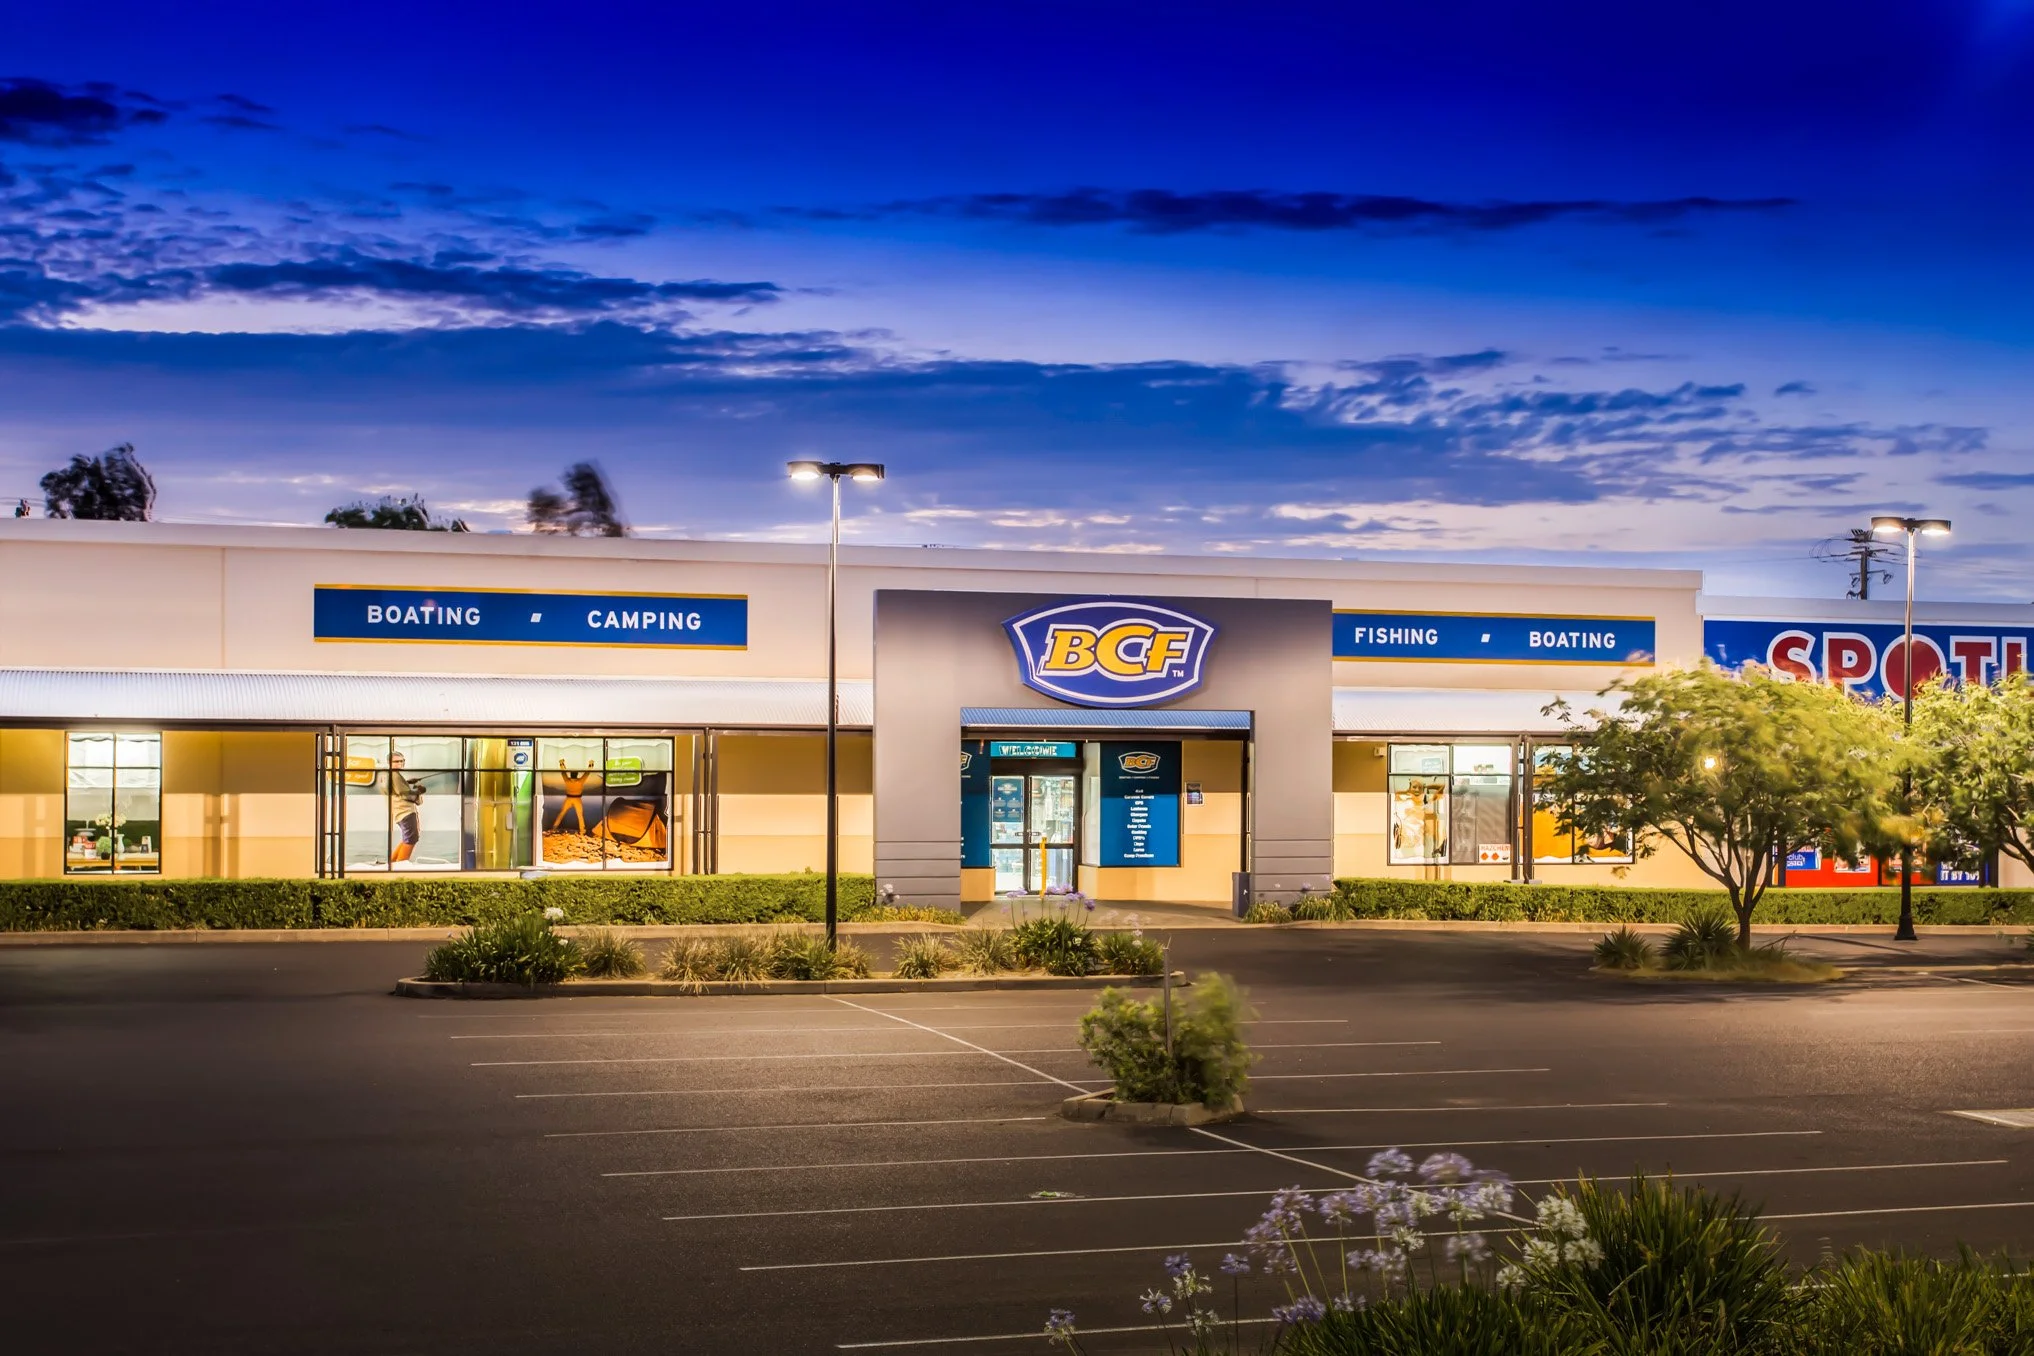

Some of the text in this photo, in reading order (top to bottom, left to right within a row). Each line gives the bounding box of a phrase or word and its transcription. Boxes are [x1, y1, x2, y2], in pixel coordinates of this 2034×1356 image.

[367, 605, 701, 630] BOATING CAMPING
[1354, 627, 1616, 649] FISHING BOATING
[1041, 621, 1190, 678] BCF
[1172, 669, 1184, 678] TM
[998, 745, 1058, 756] WELCOME
[1123, 754, 1157, 769] BCF
